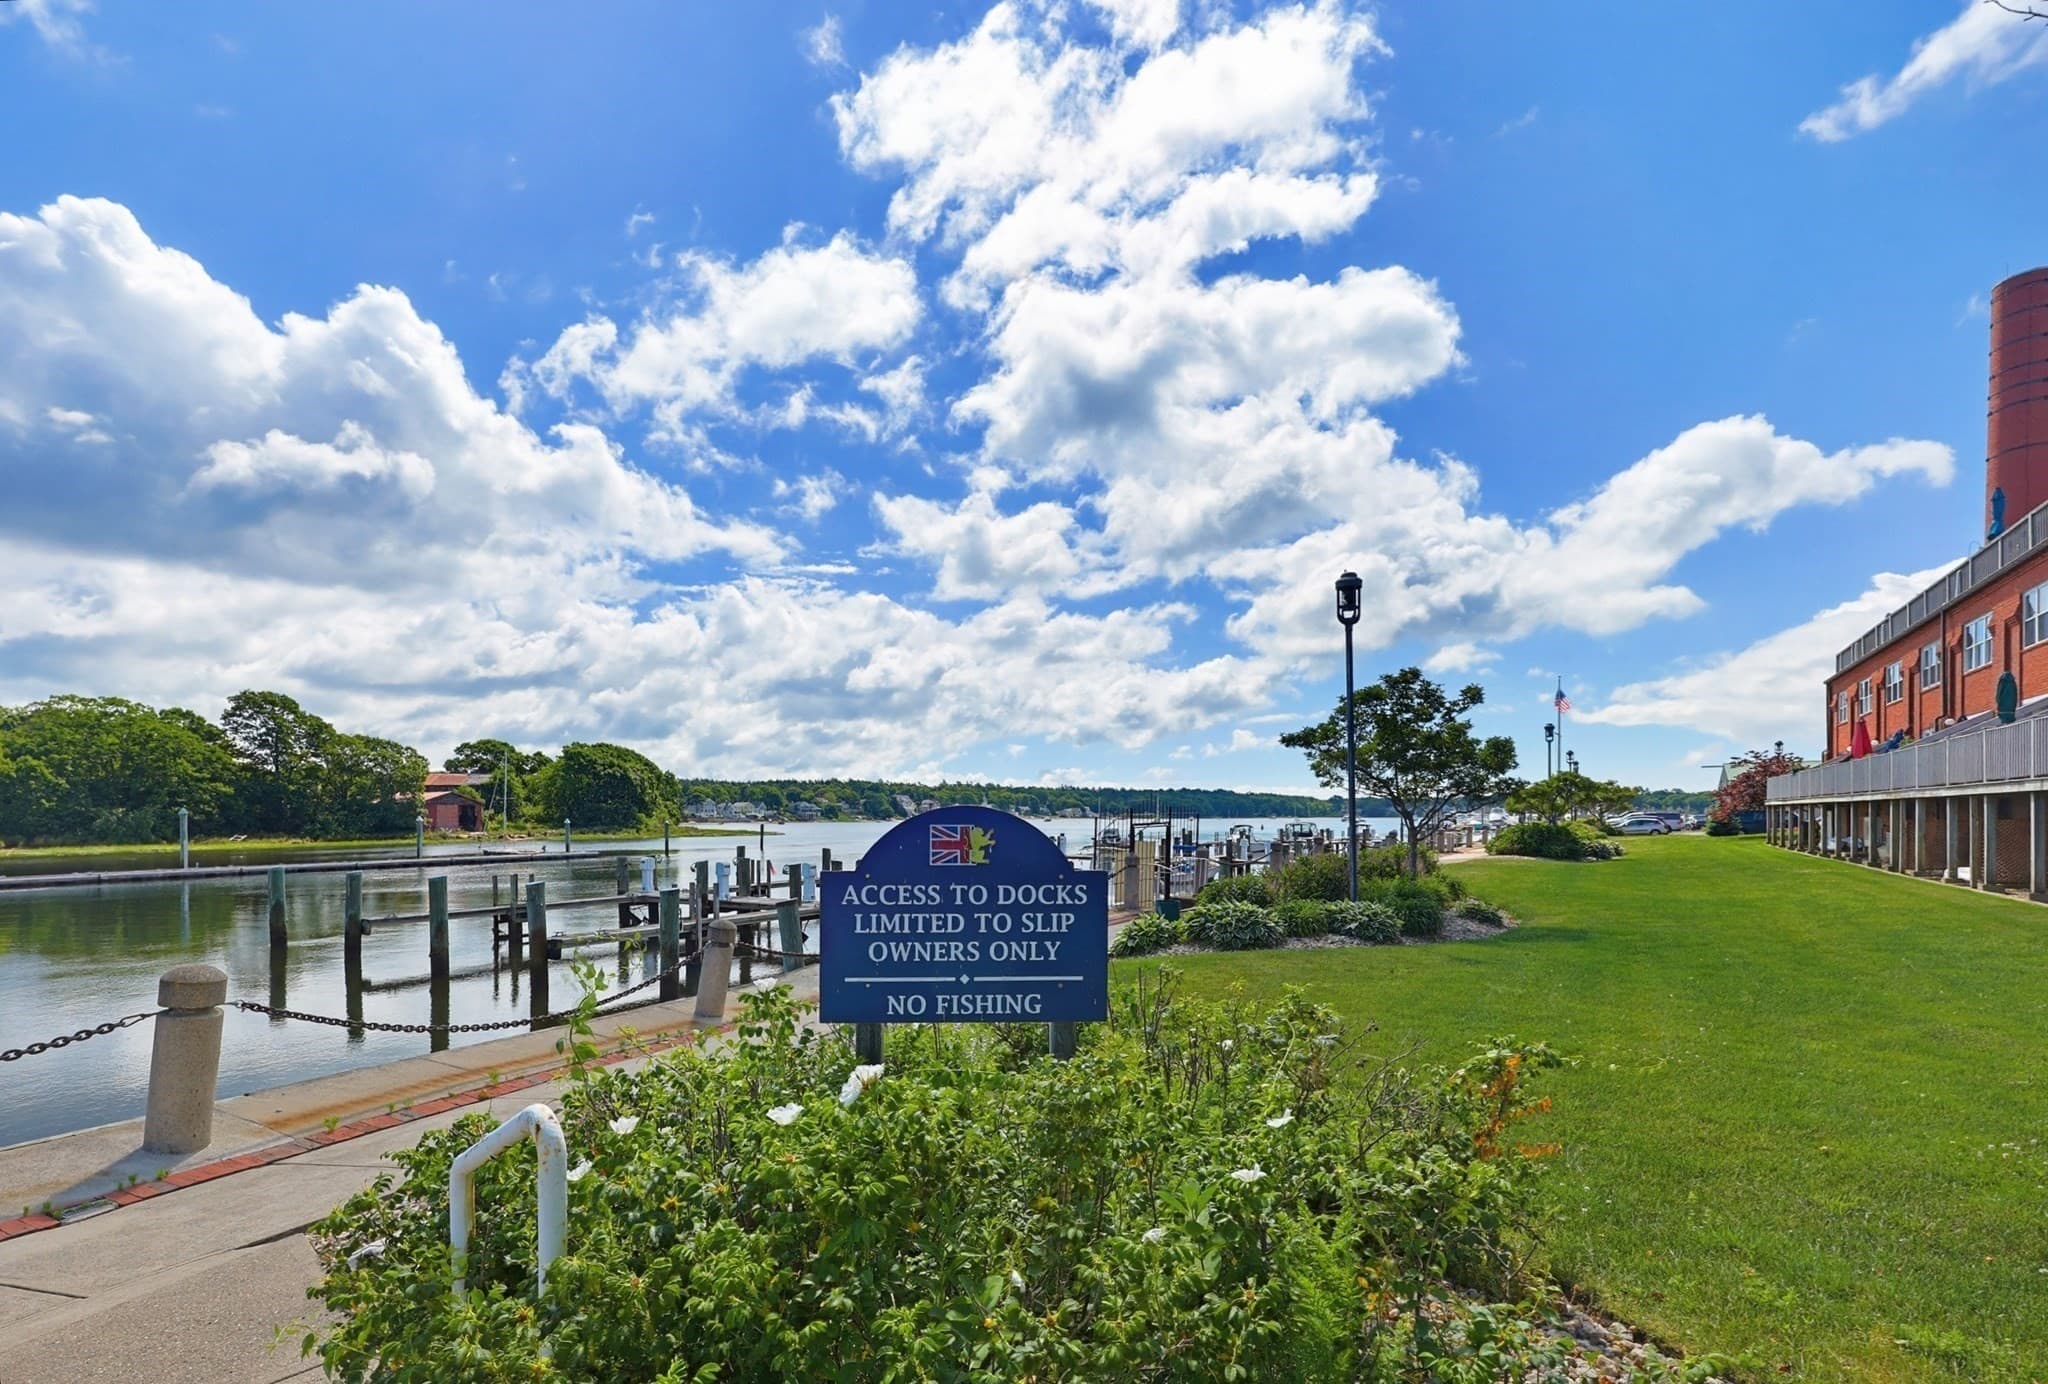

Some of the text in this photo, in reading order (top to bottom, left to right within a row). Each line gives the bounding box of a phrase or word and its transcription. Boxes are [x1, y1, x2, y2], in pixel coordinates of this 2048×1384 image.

[841, 884, 1088, 906] ACCESS TO DOCKS
[854, 912, 1075, 934] LIMITED TO SLIP
[868, 941, 1061, 962] OWNERS ONLY
[887, 993, 1042, 1015] NO FISHING
